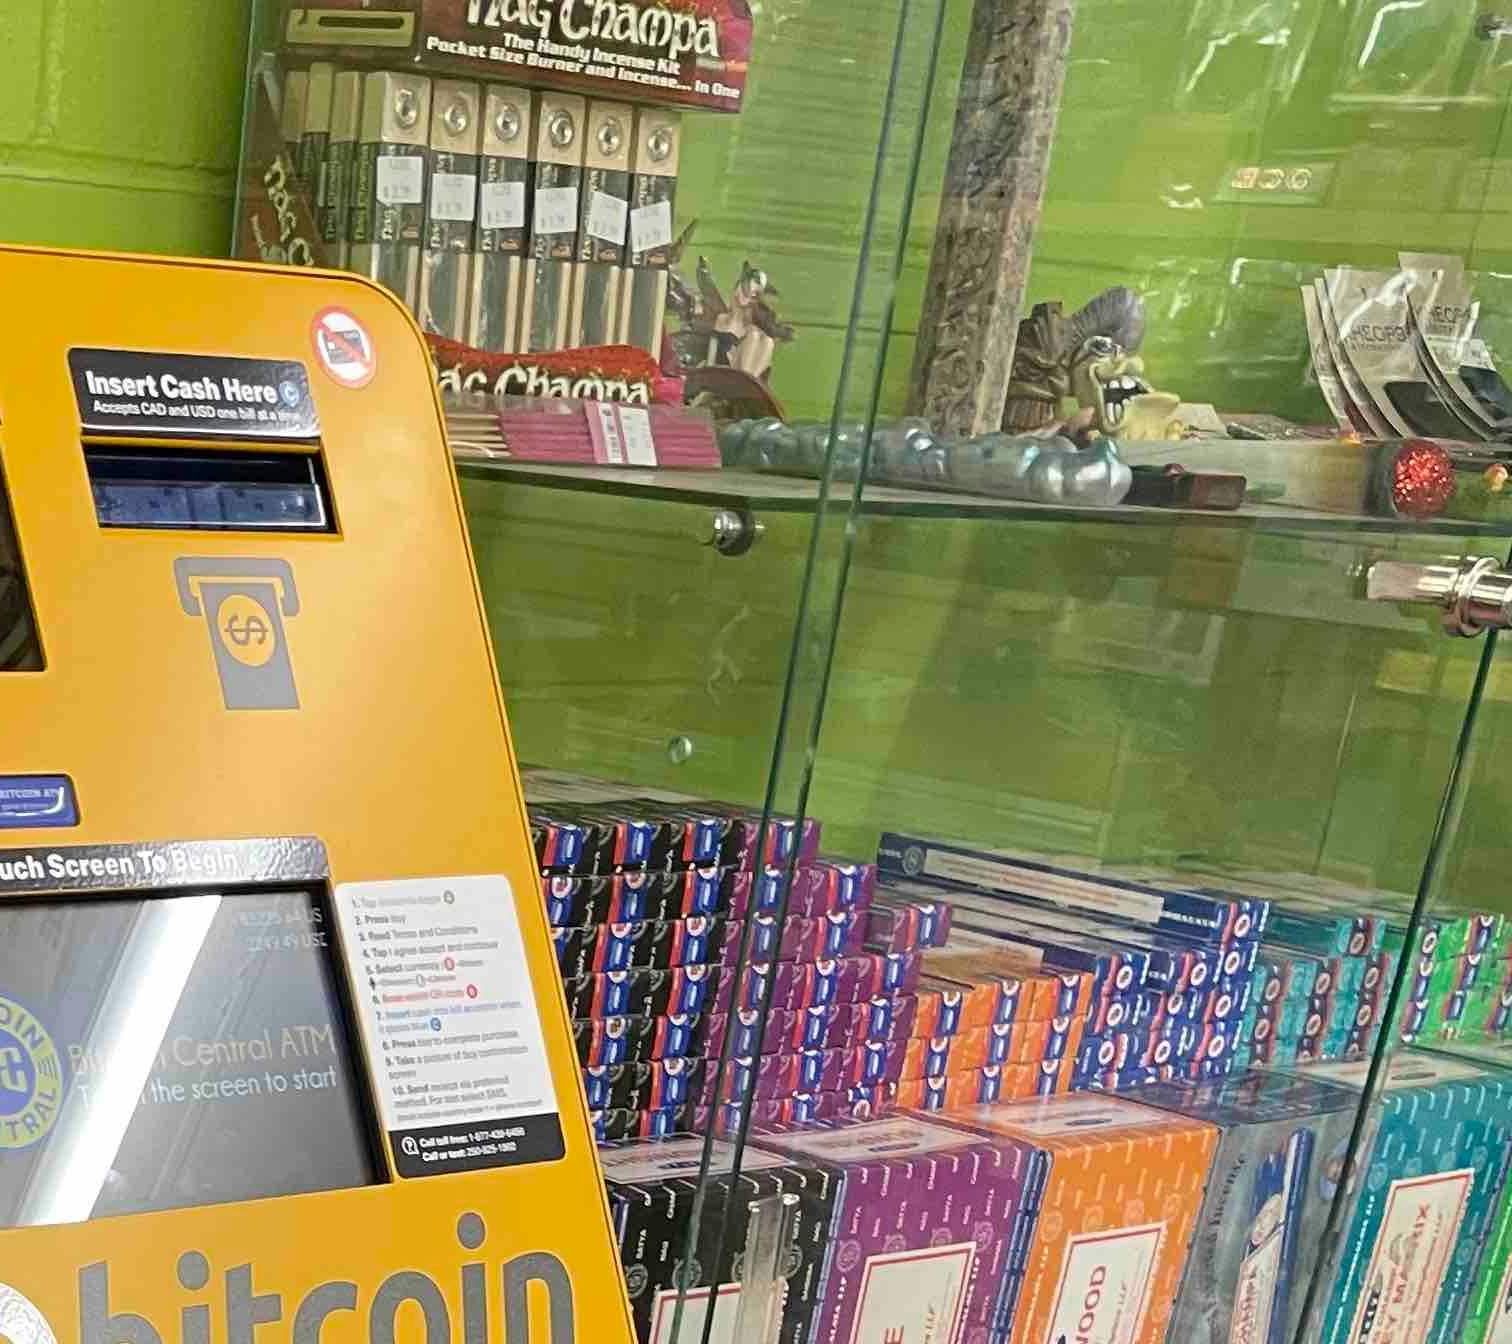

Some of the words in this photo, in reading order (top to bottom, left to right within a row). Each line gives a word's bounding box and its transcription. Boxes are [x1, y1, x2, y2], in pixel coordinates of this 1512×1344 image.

[426, 35, 488, 59] Pocket
[489, 46, 525, 65] Size
[527, 52, 584, 74] Burner
[585, 62, 616, 79] and
[712, 82, 741, 100] One
[503, 32, 535, 50] The
[537, 38, 591, 63] Handy
[593, 49, 656, 71] Incense
[657, 58, 681, 76] Kit
[86, 370, 159, 399] Insert
[160, 373, 221, 402] Cash
[222, 377, 280, 404] Here
[93, 399, 141, 416] Accepts
[141, 402, 168, 416] CAD
[168, 404, 190, 418] and
[191, 404, 217, 420] USD
[46, 853, 135, 882] Screen
[138, 850, 167, 876] To
[174, 847, 238, 875] Begin
[173, 1027, 273, 1067] Central
[280, 1022, 337, 1060] ATM
[150, 1075, 186, 1105] the
[191, 1073, 262, 1101] screen
[264, 1071, 288, 1093] to
[293, 1065, 338, 1090] start
